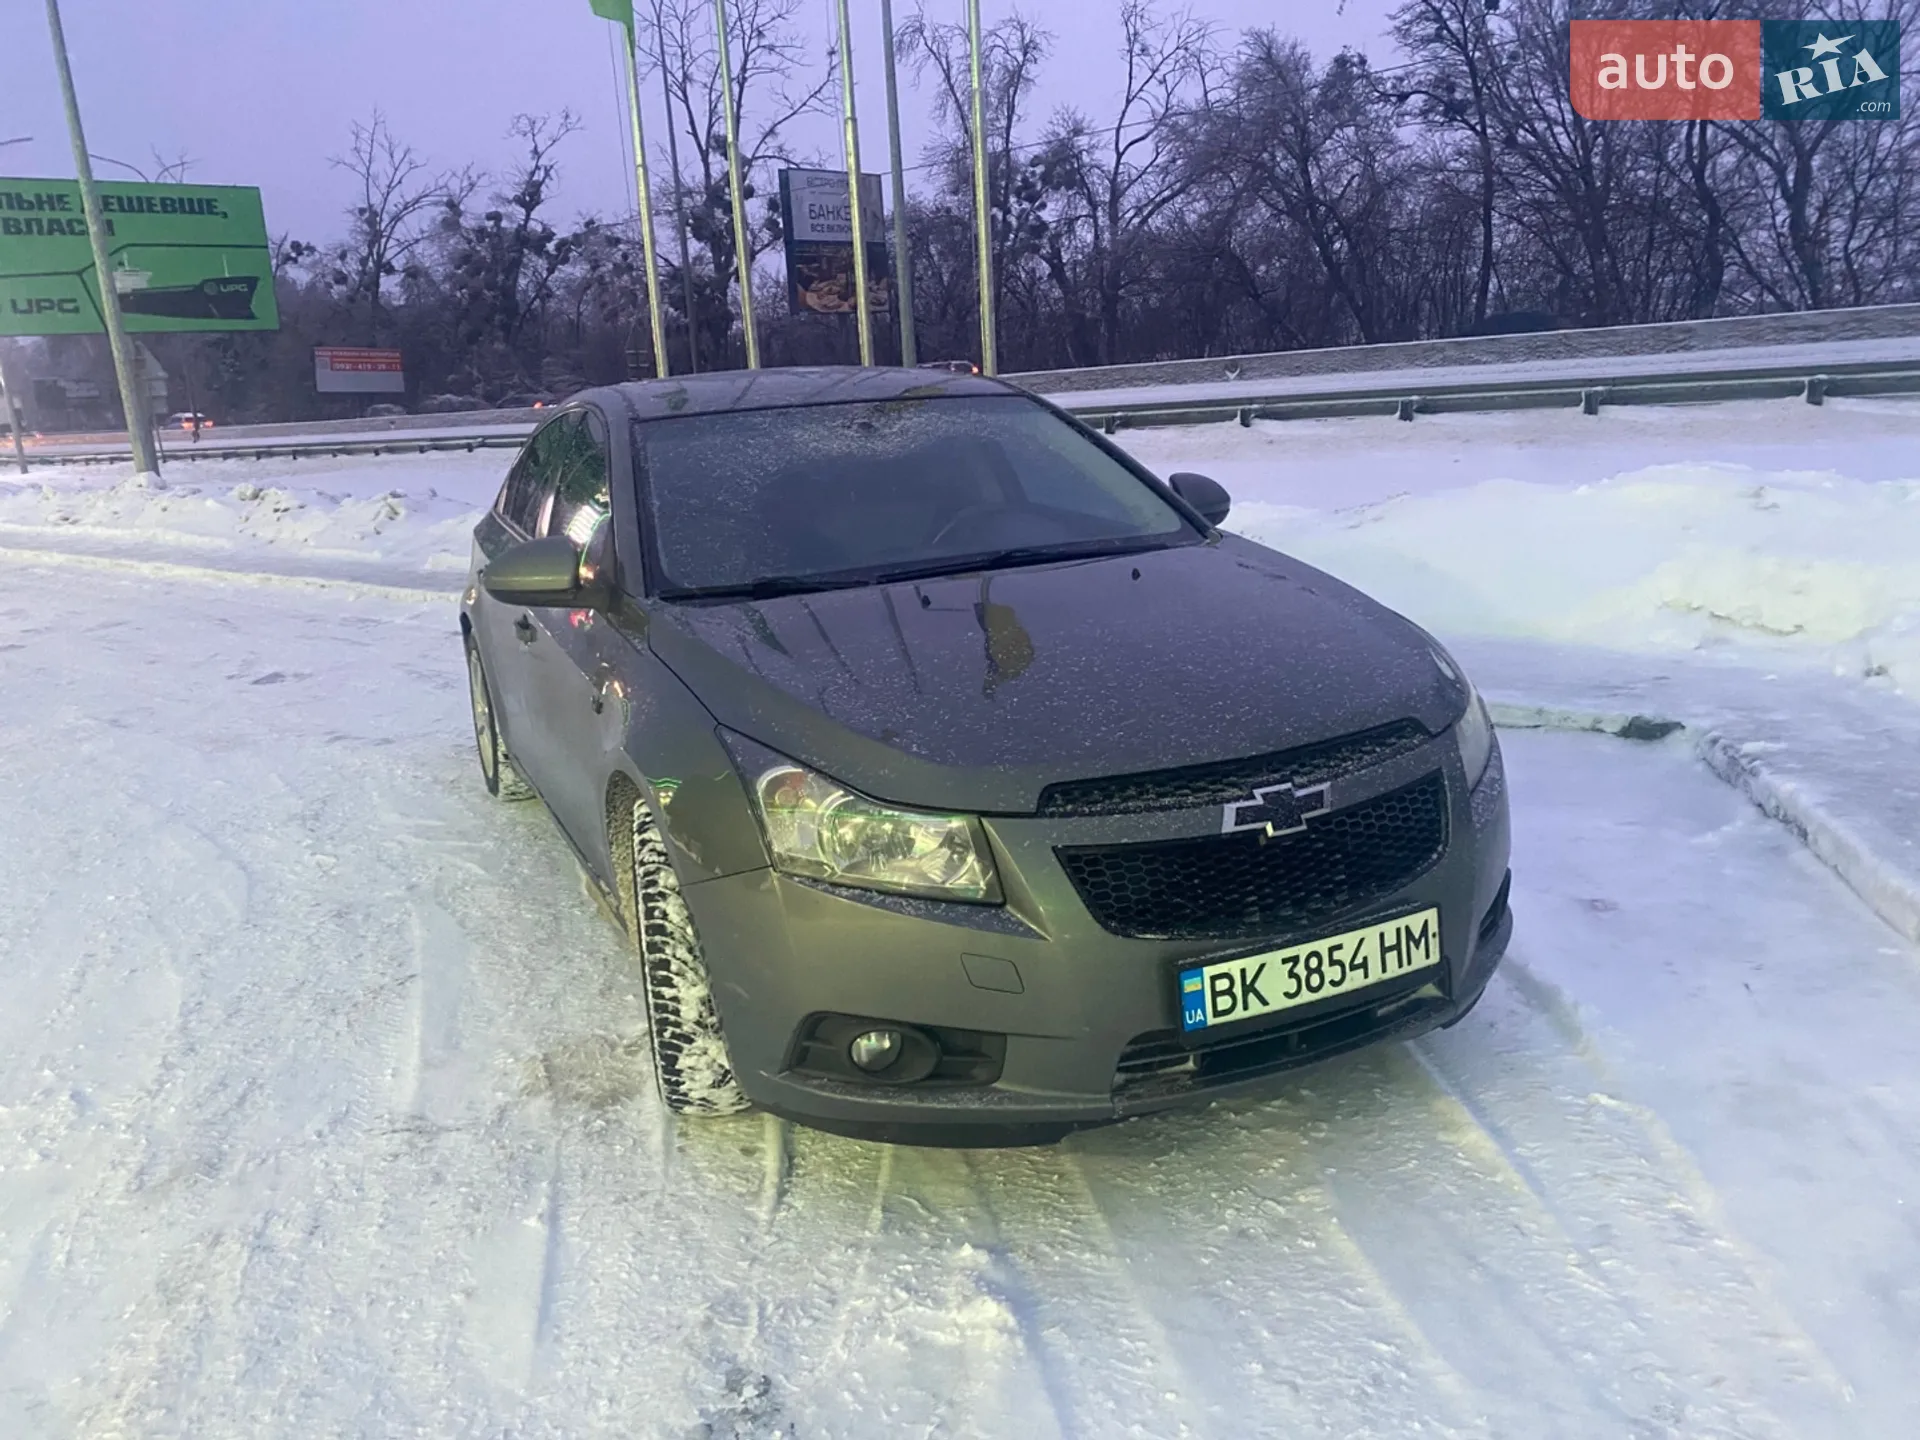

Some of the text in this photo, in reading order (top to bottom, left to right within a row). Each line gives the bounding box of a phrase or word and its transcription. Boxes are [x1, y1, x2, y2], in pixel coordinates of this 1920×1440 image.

[81, 195, 228, 219] ЕШЕВШЕ,
[220, 283, 248, 293] UPG
[11, 298, 80, 314] UPG
[1209, 919, 1431, 1018] BK 3854 HM
[1185, 1009, 1204, 1024] UA
